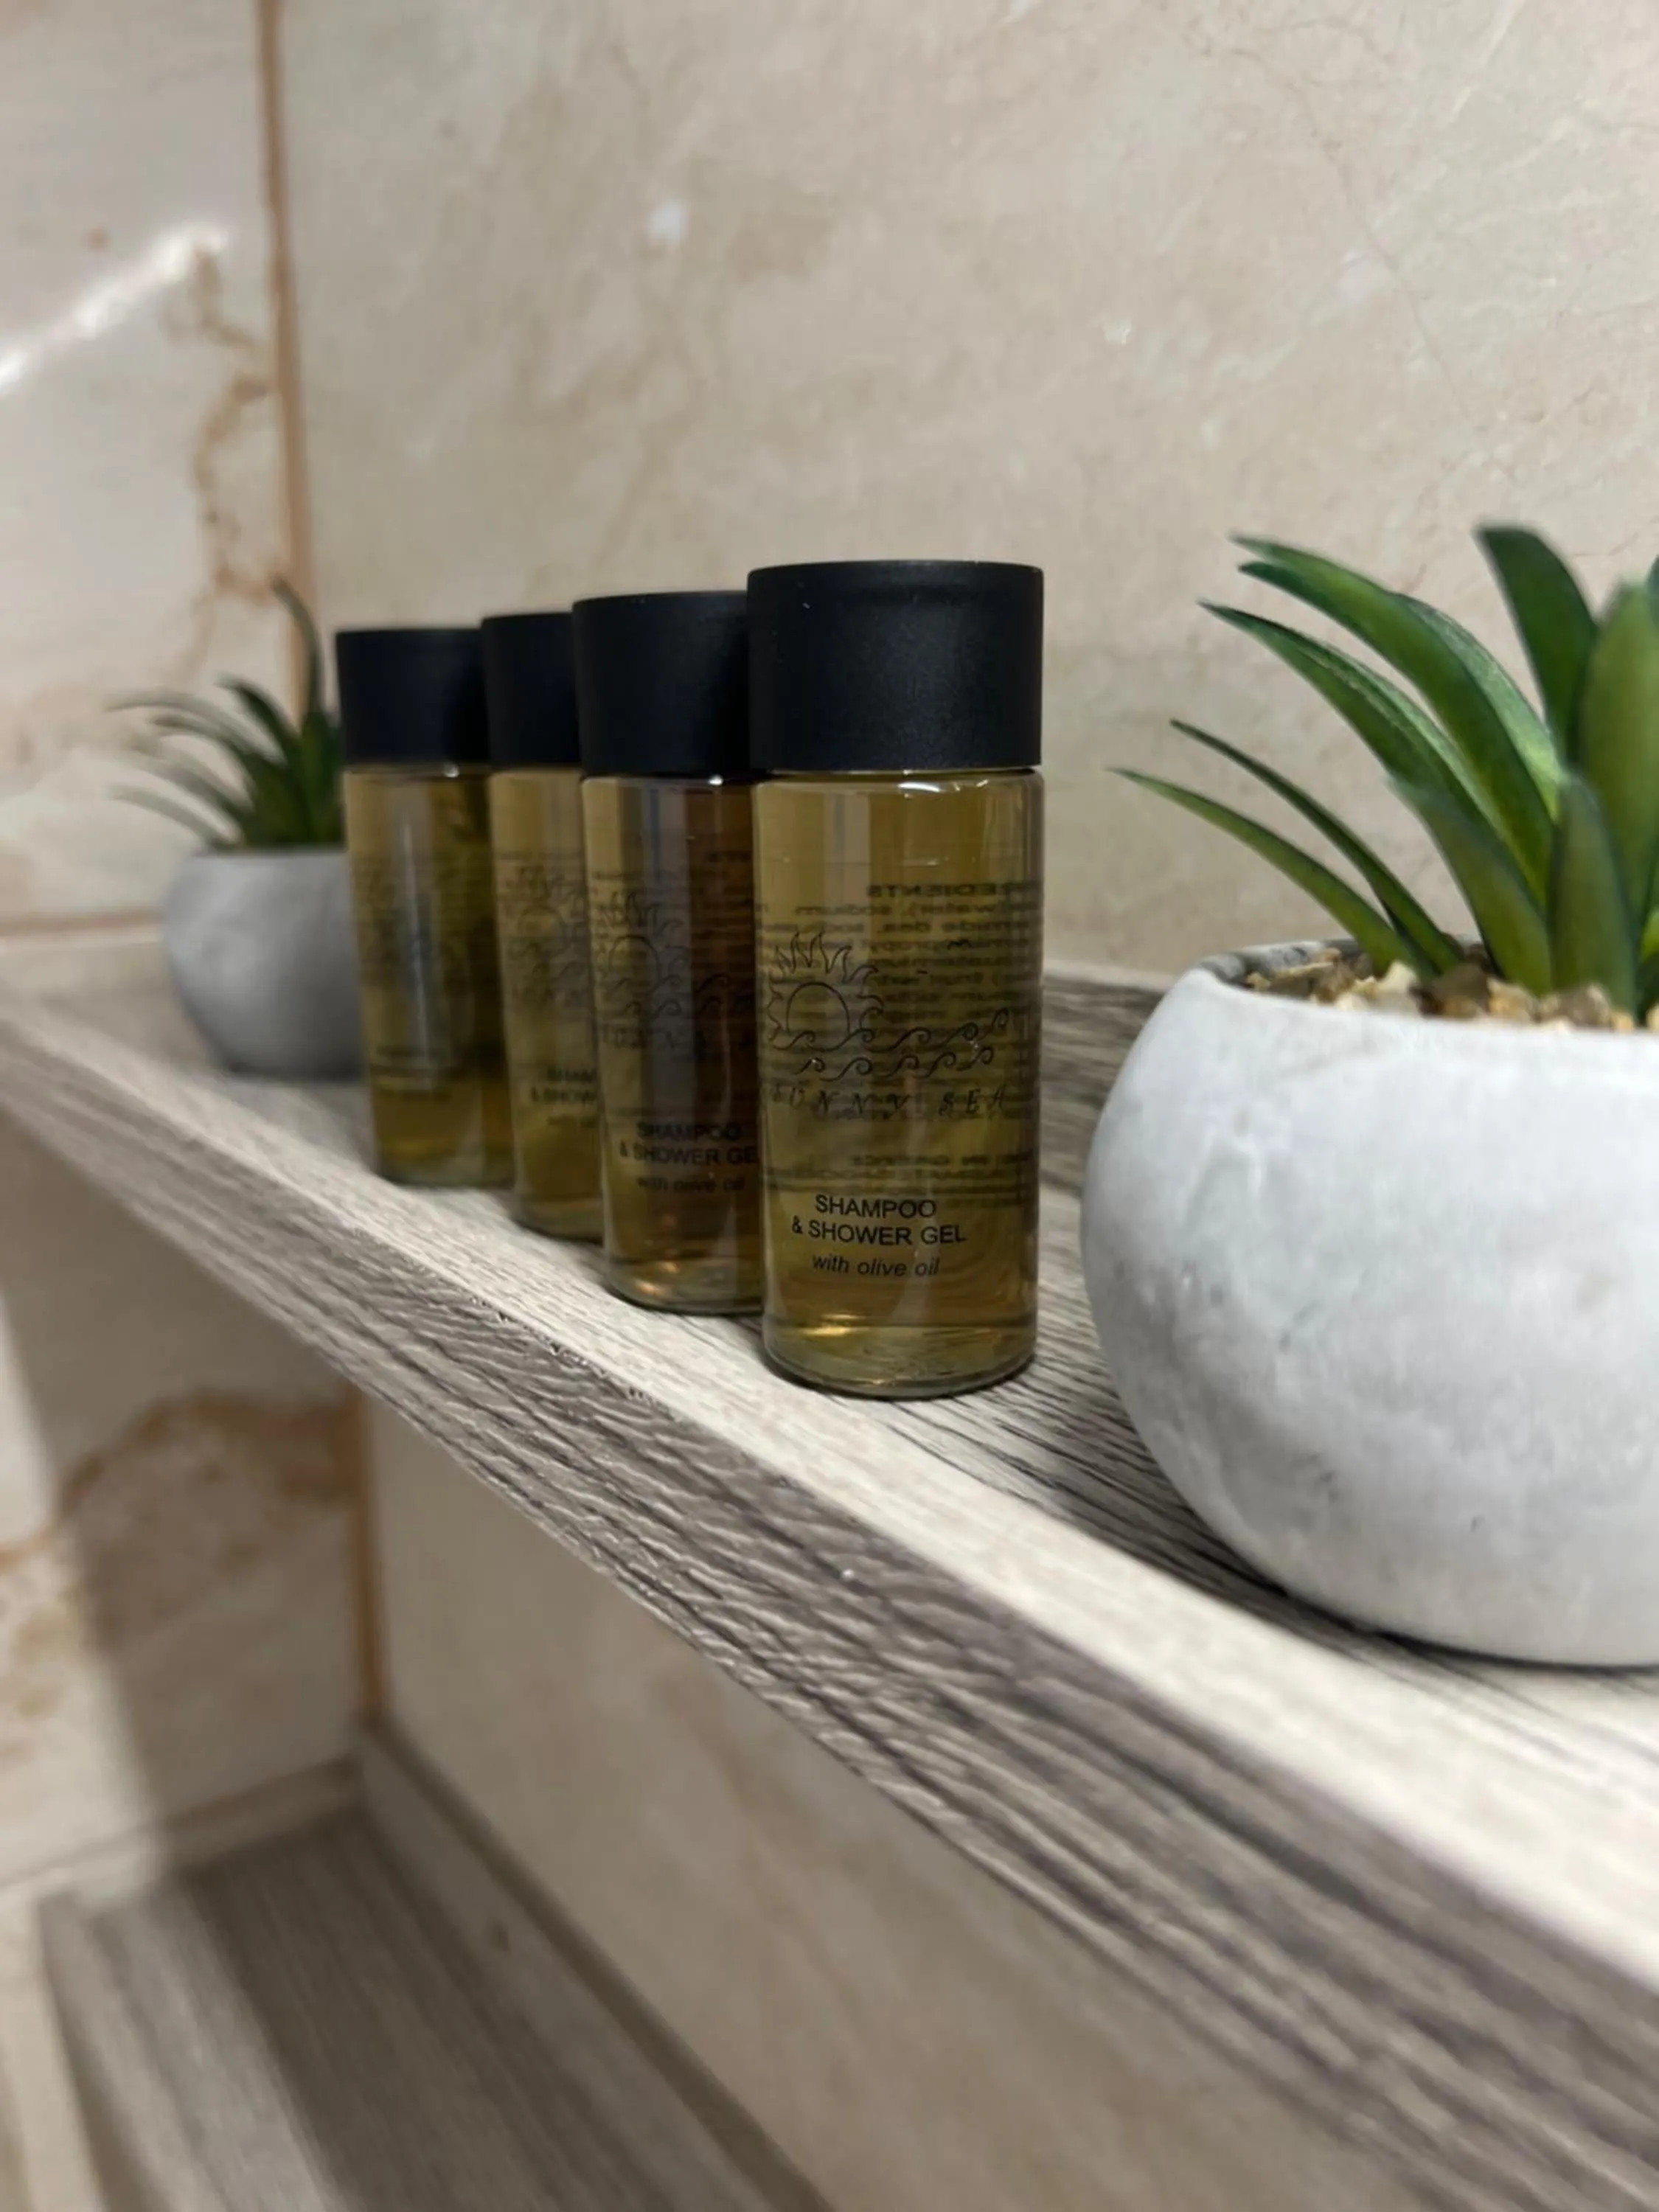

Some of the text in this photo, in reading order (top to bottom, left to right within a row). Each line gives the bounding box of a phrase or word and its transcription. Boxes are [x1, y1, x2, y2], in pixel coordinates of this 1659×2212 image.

[636, 1121, 742, 1142] SHAMPOO
[633, 1142, 721, 1166] SHOWER
[726, 1145, 759, 1166] GE
[815, 1194, 937, 1219] SHAMPOO
[791, 1215, 967, 1245] & SHOWER GEL
[812, 1253, 940, 1276] with olive oil
